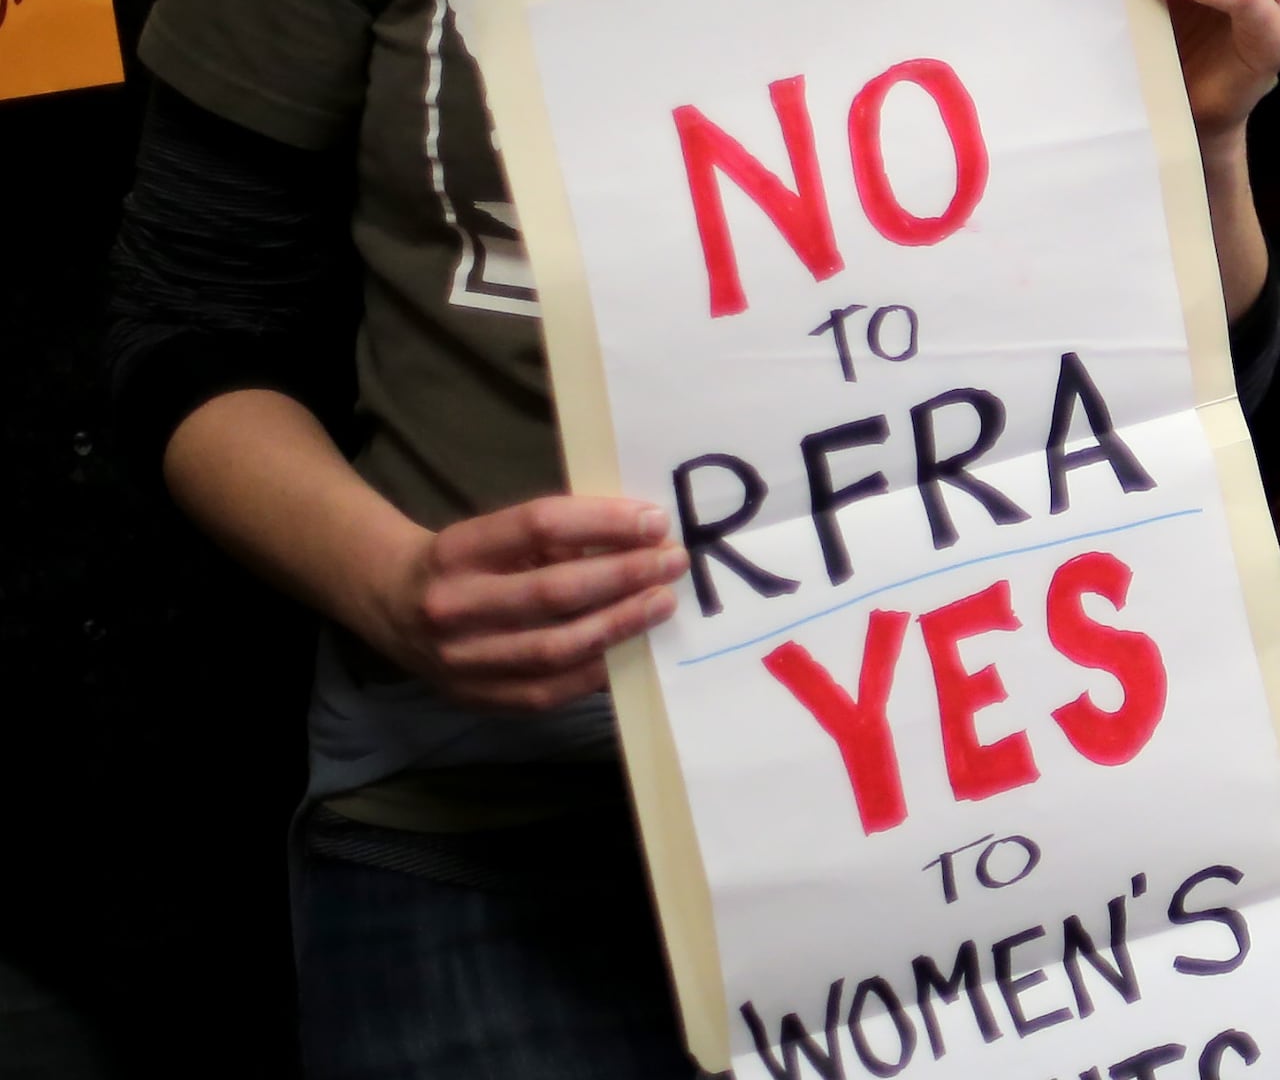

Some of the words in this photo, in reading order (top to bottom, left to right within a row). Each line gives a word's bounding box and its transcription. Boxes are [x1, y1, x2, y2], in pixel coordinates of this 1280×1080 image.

[671, 57, 989, 318] NO
[808, 303, 920, 383] TO
[672, 352, 1158, 618] RFRA
[761, 551, 1168, 836] YES
[739, 864, 1251, 1080] WOMEN'S
[922, 834, 1042, 904] TO
